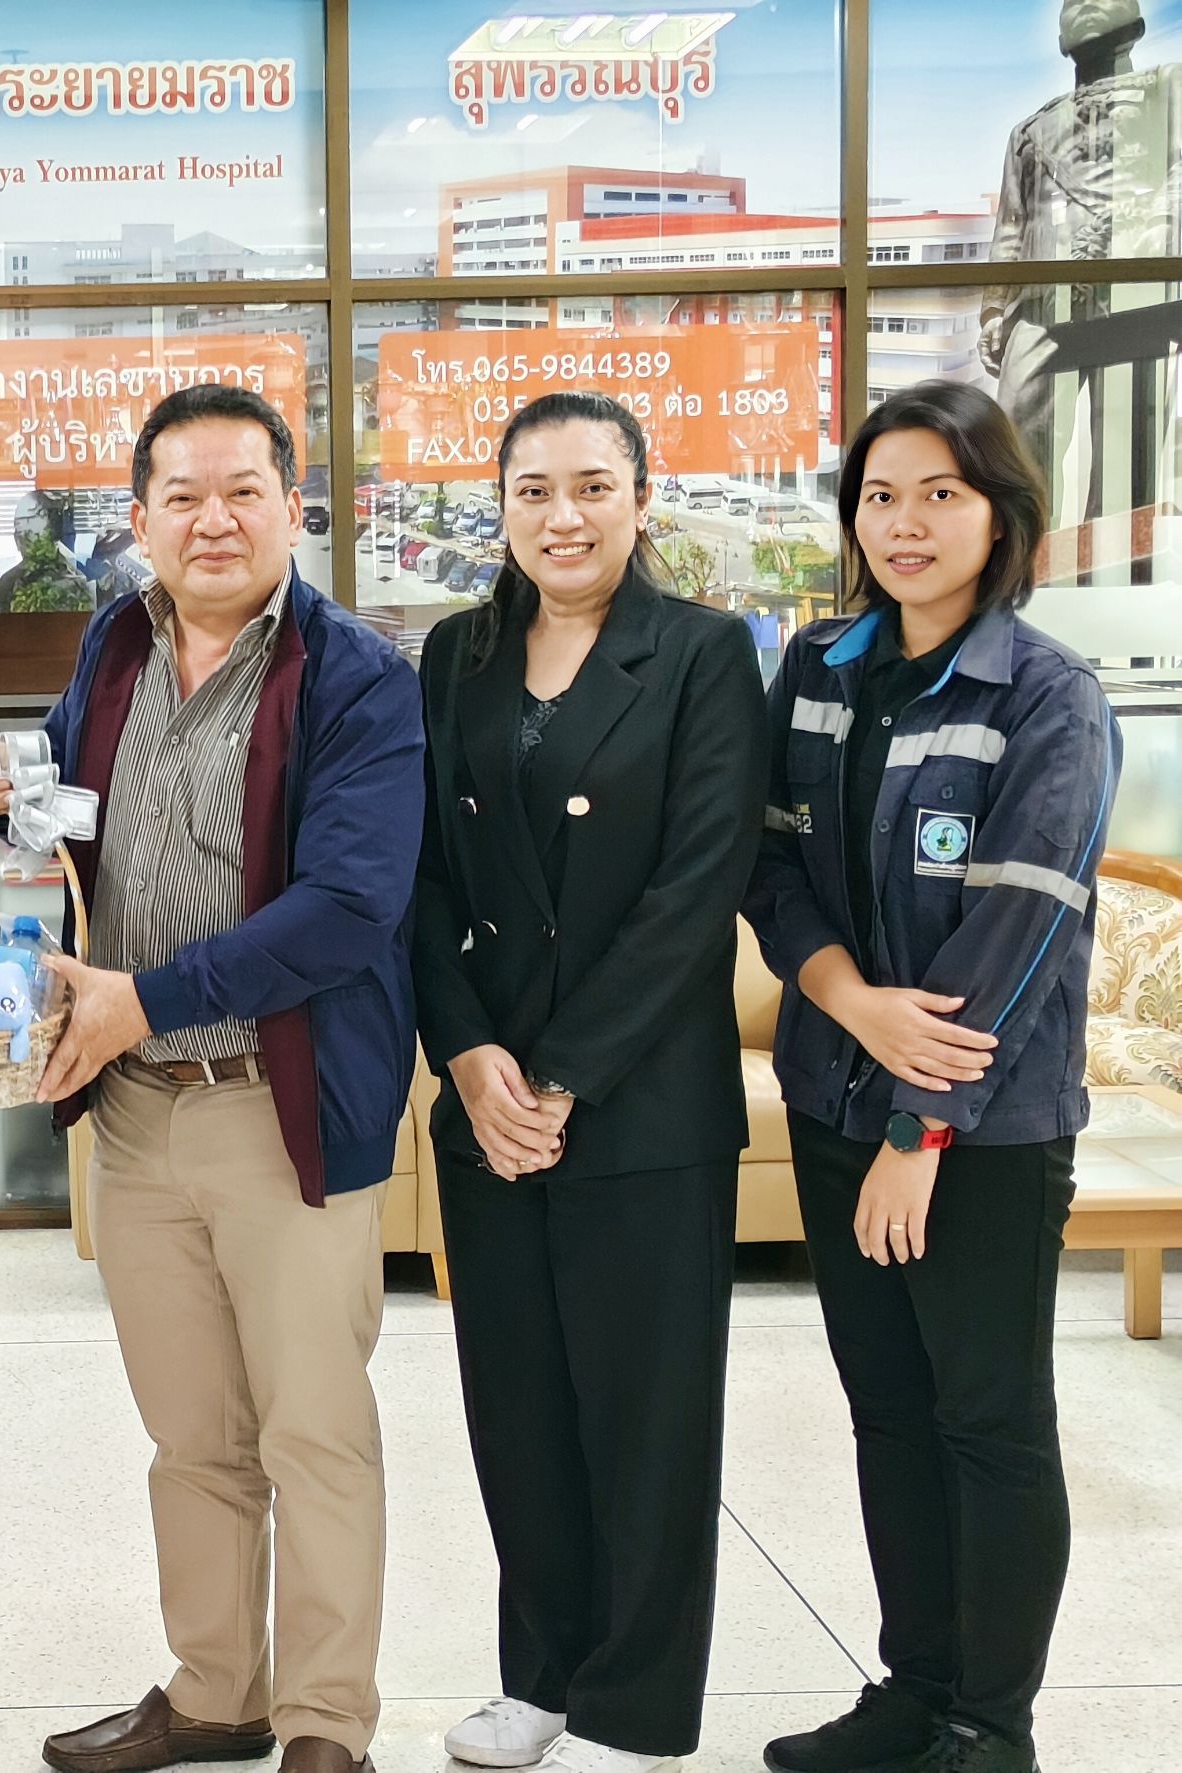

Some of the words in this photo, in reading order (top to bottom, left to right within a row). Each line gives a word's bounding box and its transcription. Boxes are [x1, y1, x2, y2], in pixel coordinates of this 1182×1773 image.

[454, 42, 712, 125] สุพรรณบุร
[35, 158, 166, 184] Yommarat
[177, 155, 284, 189] Hospital
[664, 387, 703, 418] ต่อ
